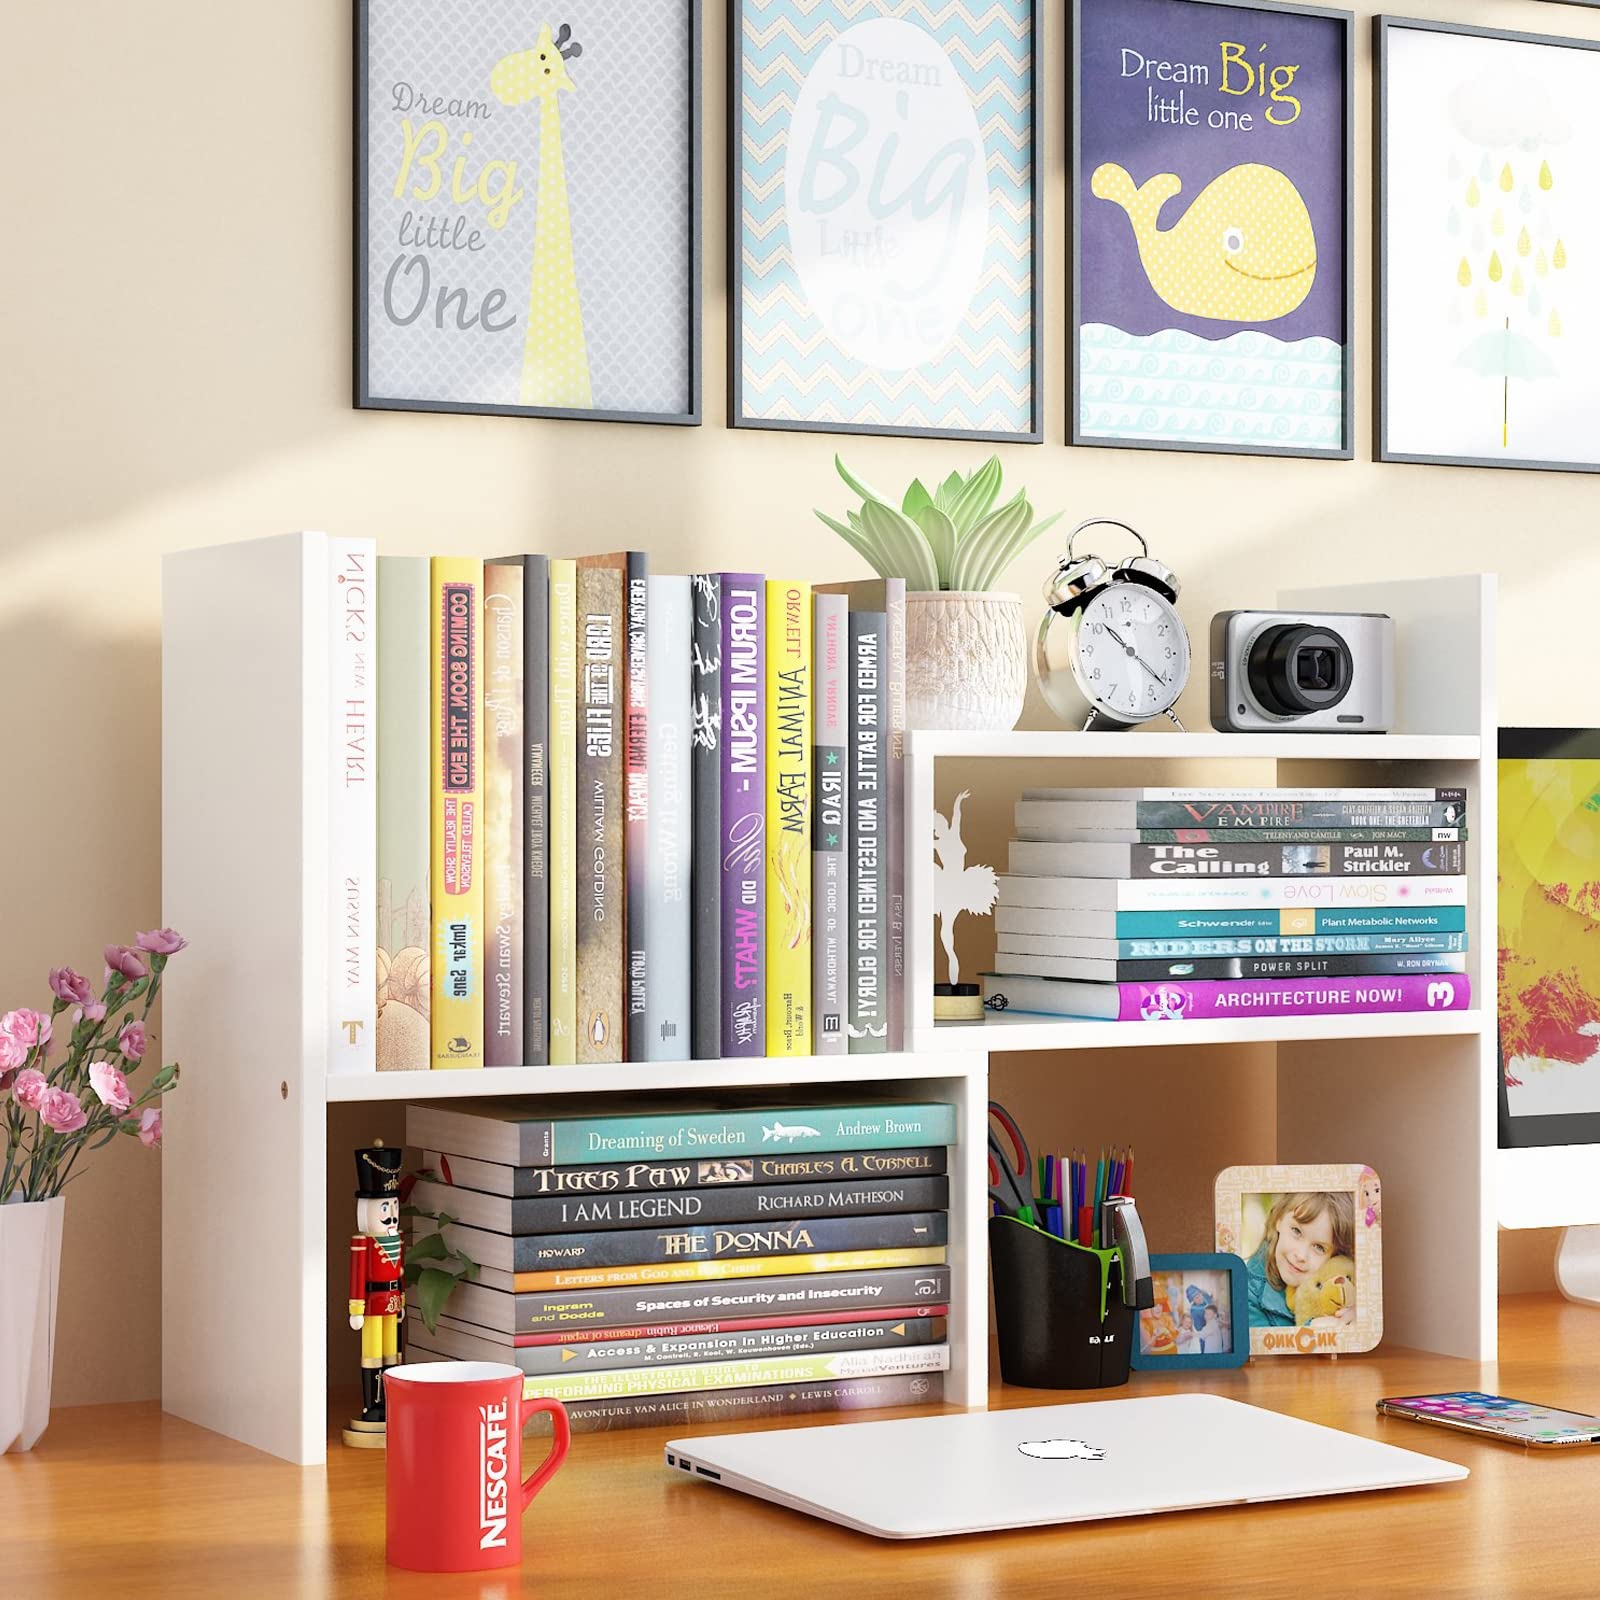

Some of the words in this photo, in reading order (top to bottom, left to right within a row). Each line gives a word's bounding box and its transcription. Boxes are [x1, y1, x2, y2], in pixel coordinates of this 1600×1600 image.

[838, 43, 942, 87] Dream
[1120, 48, 1208, 85] Dream
[1218, 41, 1301, 125] Big
[391, 82, 491, 119] Dream
[1148, 86, 1200, 126] little
[1207, 110, 1253, 131] one
[392, 117, 523, 230] Big
[399, 211, 486, 251] little
[383, 253, 517, 332] One
[1103, 607, 1113, 619] 11
[1120, 601, 1132, 613] 12
[1091, 623, 1103, 635] 10
[1183, 802, 1304, 822] VAMPIRE
[1218, 816, 1290, 827] EMPIRE
[1148, 846, 1219, 858] The
[1344, 846, 1379, 858] Paul
[1383, 846, 1404, 858] M.
[1149, 860, 1270, 875] Calling
[1343, 860, 1410, 872] Strickler
[1283, 884, 1334, 900] Love
[1339, 884, 1387, 899] Slow
[1177, 919, 1255, 928] Schwender
[1322, 919, 1346, 927] Plant
[1348, 917, 1393, 927] Metabolic
[1395, 917, 1438, 926] Networks
[1130, 939, 1252, 957] RIDERS
[1254, 939, 1277, 953] ON
[1279, 938, 1314, 953] THE
[1315, 937, 1370, 952] STORM
[1253, 962, 1292, 972] POWER
[1296, 961, 1328, 971] SPLIT
[1396, 960, 1405, 968] W.
[1406, 960, 1420, 968] RON
[1214, 990, 1350, 1008] ARCHITECTURE
[1355, 988, 1402, 1003] NOW!
[588, 1130, 666, 1152] Dreaming
[668, 1128, 685, 1146] of
[687, 1126, 745, 1146] Sweden
[836, 1119, 881, 1137] Andrew
[885, 1119, 921, 1134] Brown
[533, 1167, 620, 1192] TIGER
[624, 1164, 691, 1189] PAW
[760, 1159, 834, 1177] CHARLES
[840, 1157, 858, 1174] A.
[862, 1154, 933, 1171] CORNELL
[561, 1204, 568, 1222] I
[574, 1202, 612, 1221] AM
[618, 1196, 702, 1219] LEGEND
[757, 1194, 825, 1211] RICHARD
[828, 1190, 904, 1208] MATHESON
[538, 1247, 586, 1259] HOWARD
[657, 1233, 708, 1255] THE
[712, 1229, 815, 1256] DONNA
[555, 1274, 605, 1285] LETTERS
[608, 1272, 638, 1282] FROM
[640, 1269, 669, 1280] GOD
[635, 1299, 691, 1312] Spaces
[693, 1297, 710, 1307] of
[711, 1292, 775, 1307] Security
[777, 1289, 805, 1301] and
[808, 1285, 883, 1300] Insecurity
[543, 1302, 593, 1312] Ingram
[531, 1314, 555, 1322] and
[558, 1310, 605, 1320] Dodds
[604, 1329, 642, 1340] dreams
[646, 1325, 678, 1337] Rubin
[680, 1322, 719, 1334] Eleanor
[558, 1332, 589, 1344] repair
[587, 1347, 641, 1359] Access
[645, 1344, 657, 1354] &
[662, 1339, 737, 1353] Expansion
[761, 1330, 808, 1347] Higher
[813, 1327, 884, 1341] Education
[592, 1331, 603, 1342] of
[1263, 1326, 1337, 1353] ФИКСИК
[524, 1381, 624, 1400] PERFORMING
[627, 1376, 700, 1393] PHYSICAL
[703, 1366, 814, 1386] EXAMINATIONS
[570, 1406, 632, 1420] AVONTURE
[634, 1404, 657, 1414] VAN
[659, 1400, 690, 1412] ALICE
[692, 1400, 704, 1410] IN
[706, 1393, 784, 1408] WONDERLAND
[801, 1391, 833, 1401] LEWIS
[834, 1386, 884, 1397] CARROLL
[480, 1403, 508, 1551] NESCAFÉ
